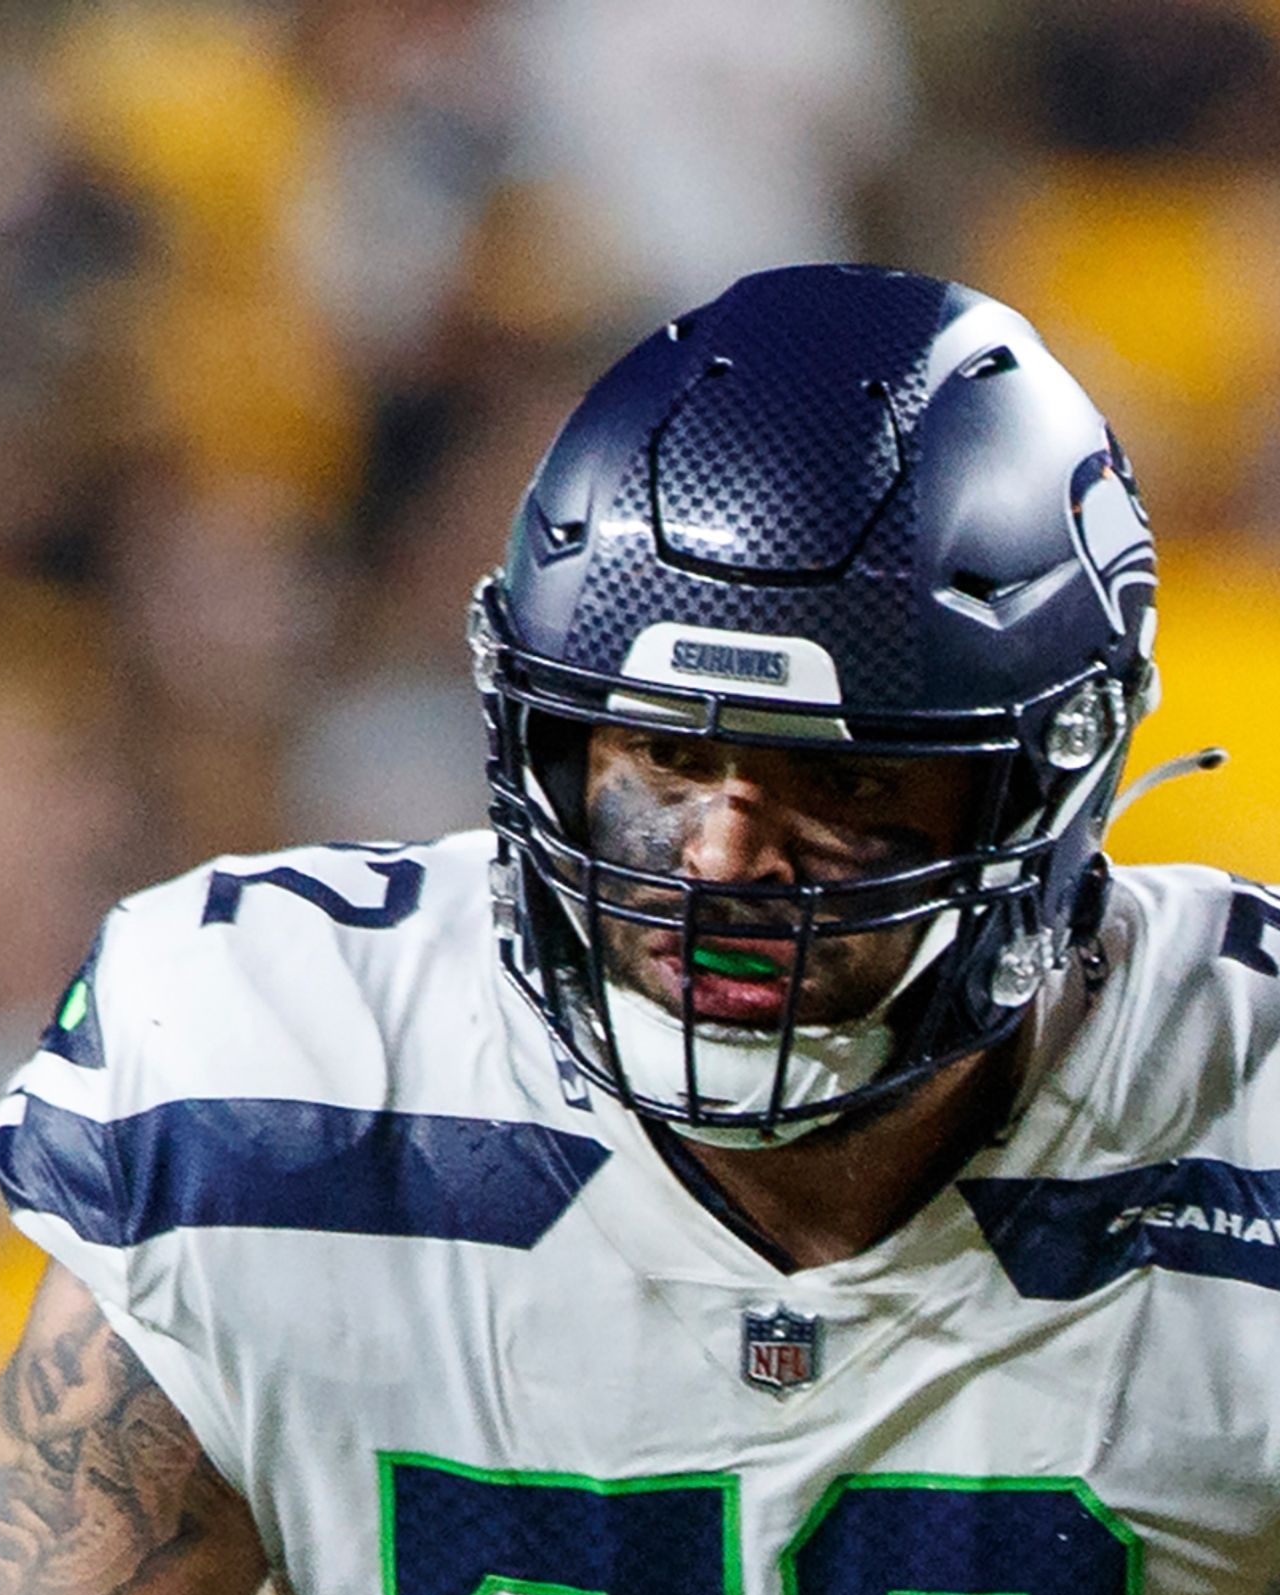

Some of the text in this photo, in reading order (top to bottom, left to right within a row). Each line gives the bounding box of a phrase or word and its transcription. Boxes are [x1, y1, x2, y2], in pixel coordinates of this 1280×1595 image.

[670, 640, 792, 686] SEAHAWKS
[200, 841, 448, 930] 2
[753, 1344, 806, 1381] NFL
